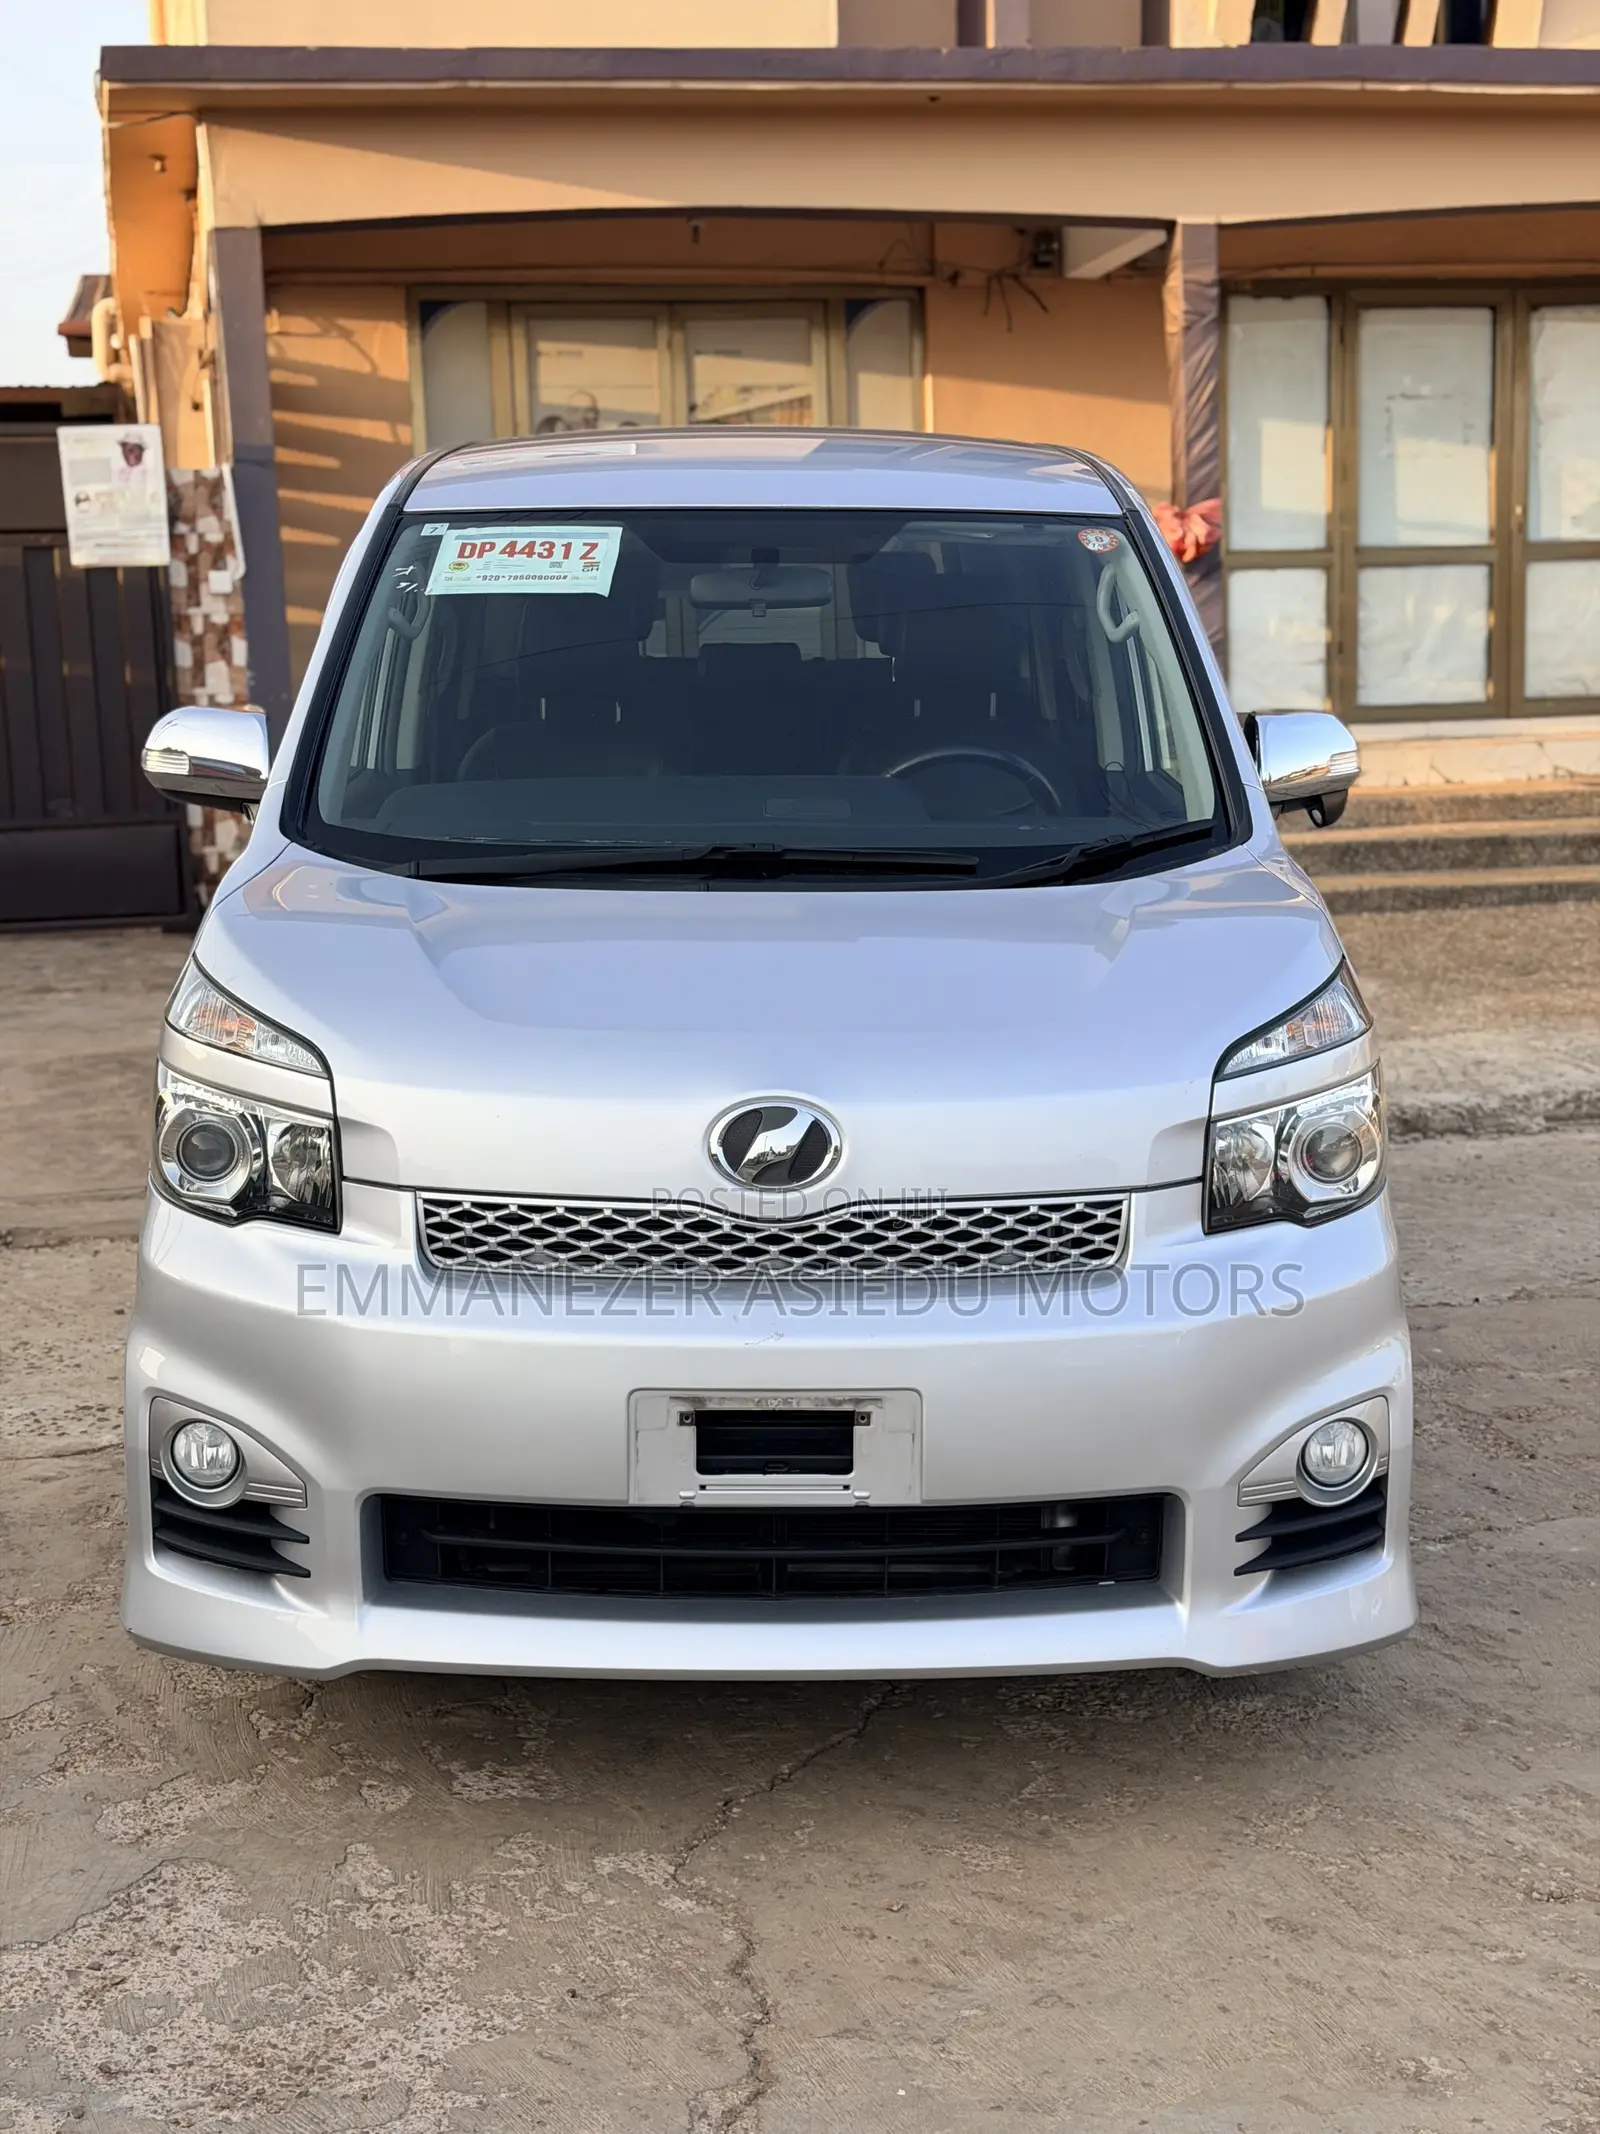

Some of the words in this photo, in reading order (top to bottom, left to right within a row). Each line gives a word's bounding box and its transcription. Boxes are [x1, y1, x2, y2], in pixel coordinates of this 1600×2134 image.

[456, 541, 496, 559] DP
[498, 540, 573, 560] 4431
[579, 542, 599, 560] Z
